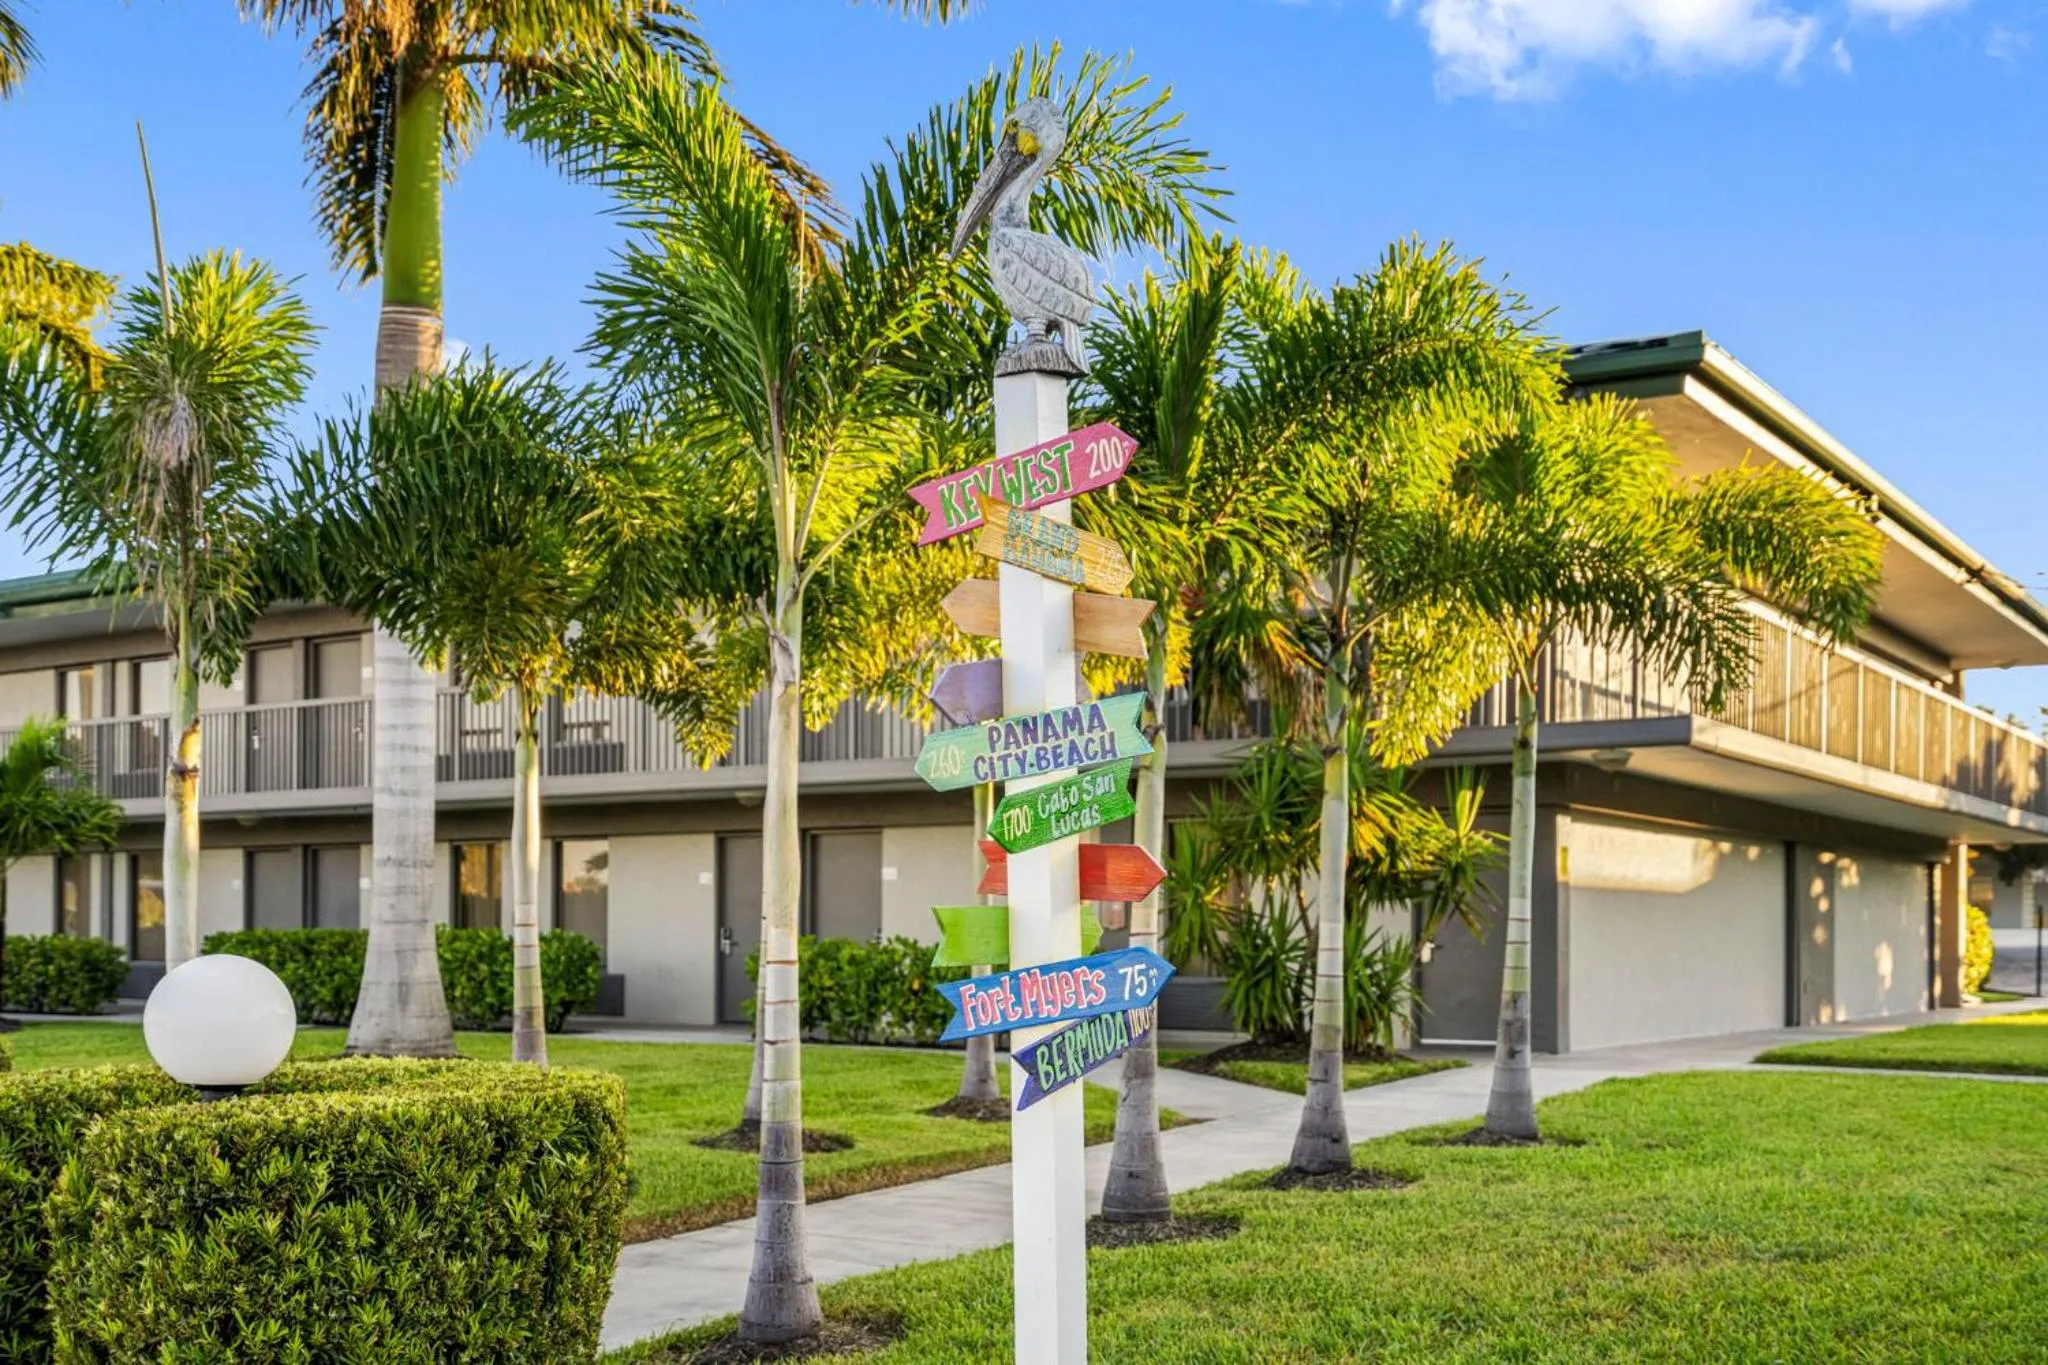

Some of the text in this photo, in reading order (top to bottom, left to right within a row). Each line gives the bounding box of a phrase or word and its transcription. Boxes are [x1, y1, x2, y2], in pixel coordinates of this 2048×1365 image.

[938, 464, 994, 530] KEY
[996, 441, 1075, 507] WEST
[1085, 436, 1123, 479] 200
[987, 703, 1107, 753] PANAMA
[929, 744, 961, 778] 260
[972, 749, 1028, 782] CITY
[1034, 731, 1119, 771] BEACH
[1037, 785, 1080, 819] Cabo
[1082, 774, 1116, 801] San
[1002, 805, 1030, 841] 1700
[959, 974, 1022, 1031] Fort
[1017, 965, 1107, 1018] Myers
[1118, 963, 1148, 1000] 75
[1034, 1012, 1130, 1092] BERMUDA
